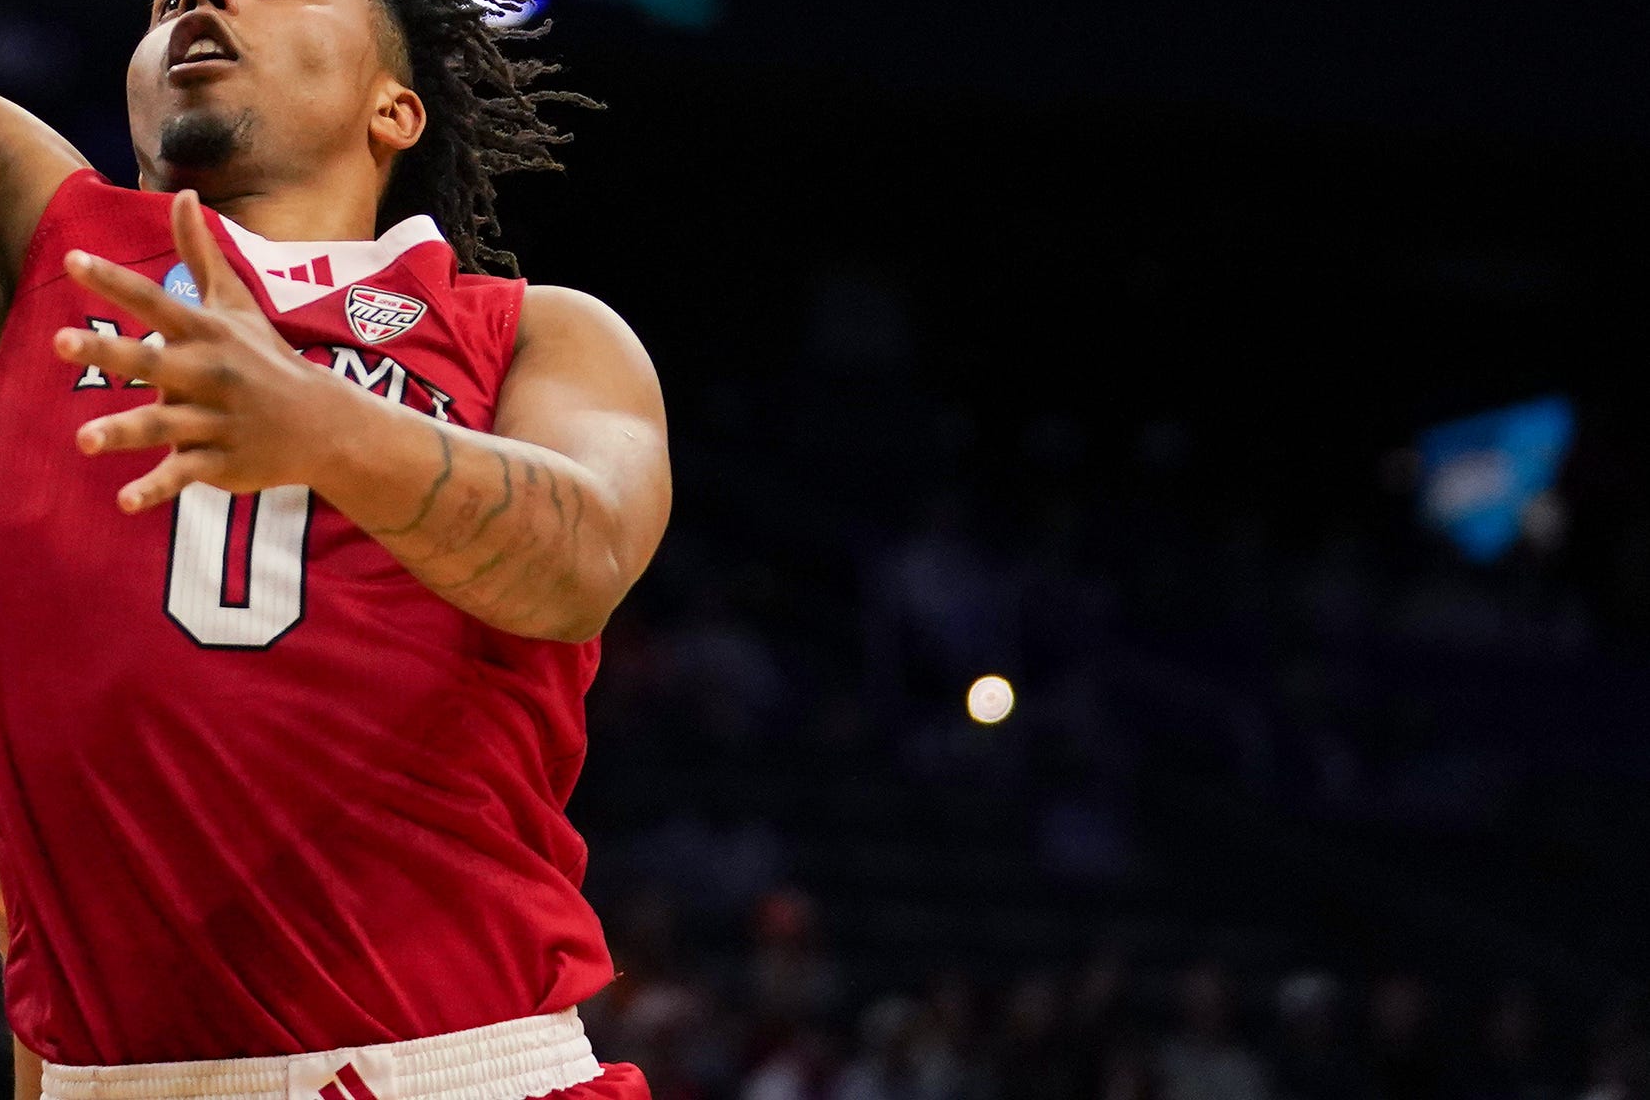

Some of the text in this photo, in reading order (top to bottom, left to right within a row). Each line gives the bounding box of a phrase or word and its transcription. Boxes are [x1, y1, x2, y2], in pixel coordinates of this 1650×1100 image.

[170, 279, 200, 298] NC
[349, 300, 418, 327] MAC
[162, 481, 312, 651] 0
